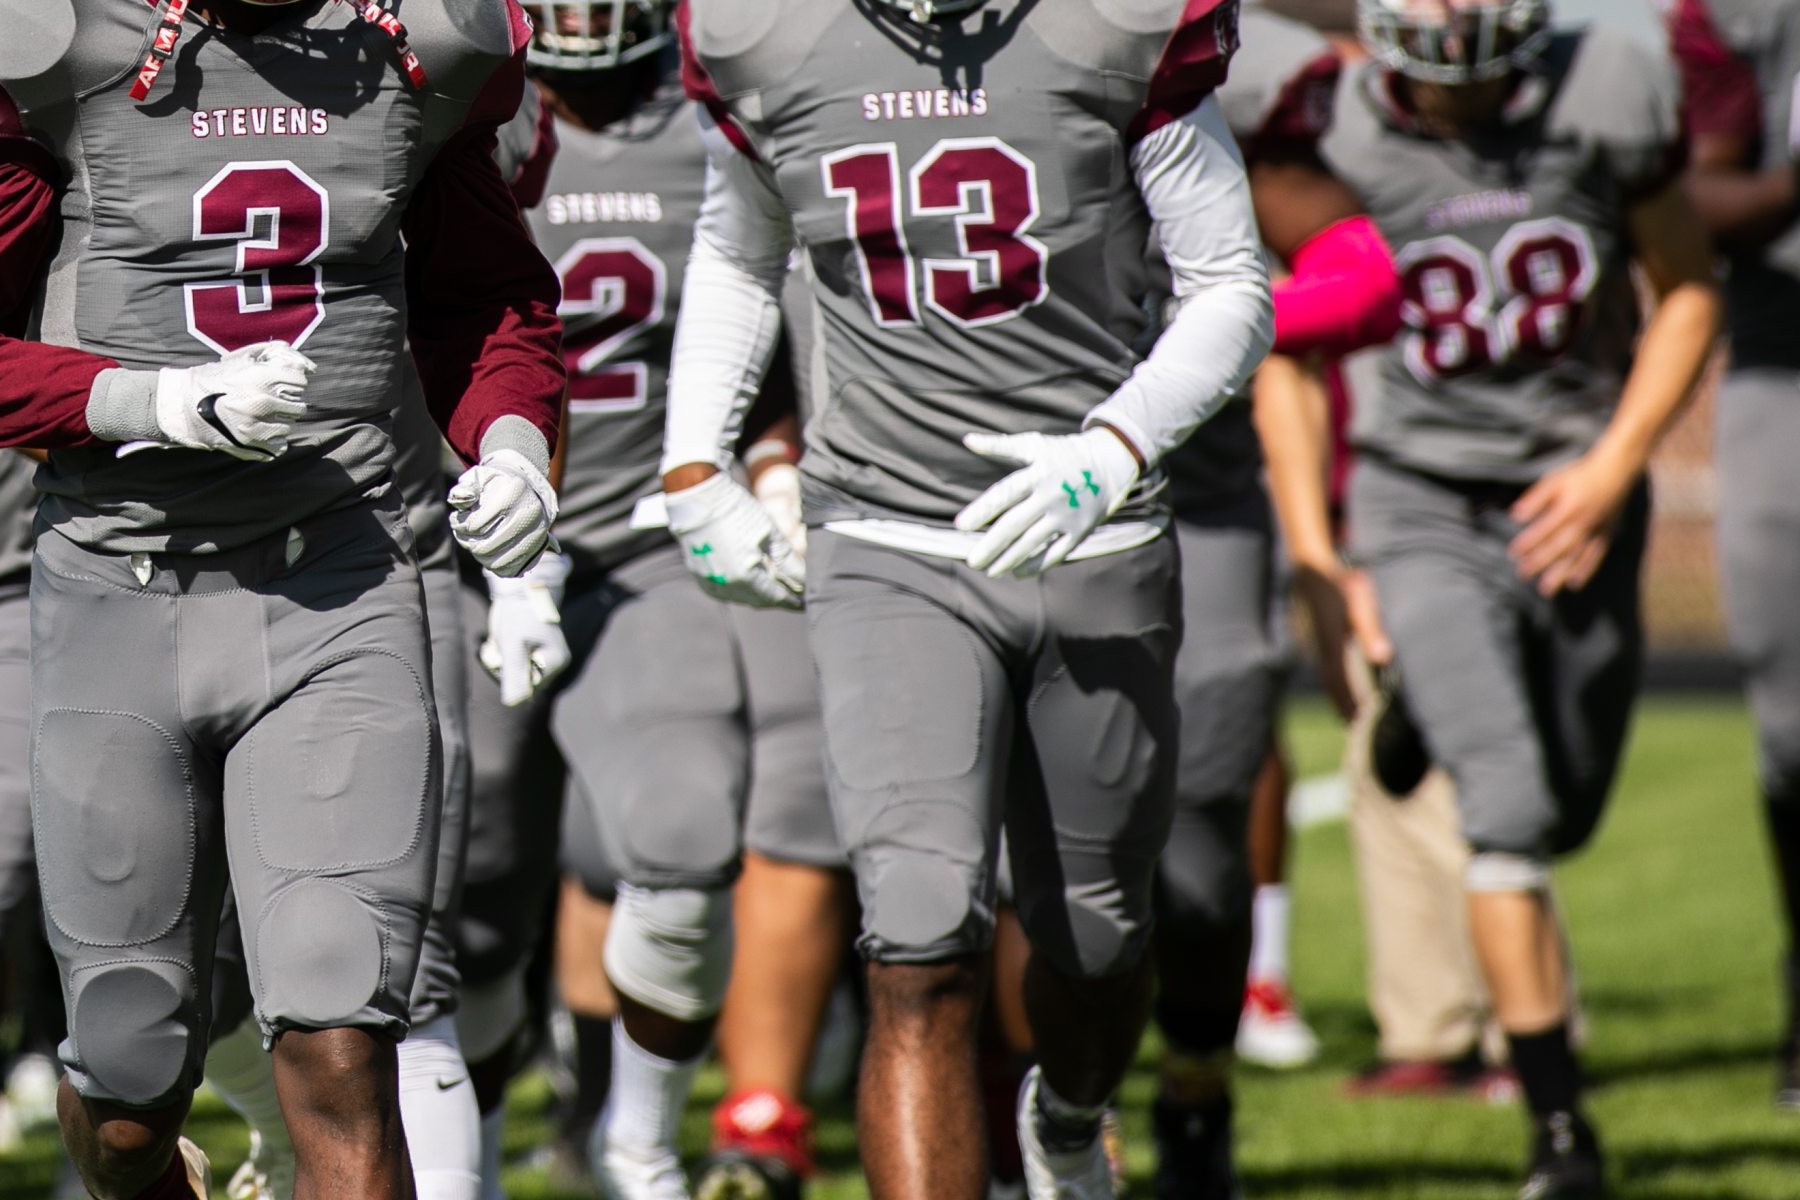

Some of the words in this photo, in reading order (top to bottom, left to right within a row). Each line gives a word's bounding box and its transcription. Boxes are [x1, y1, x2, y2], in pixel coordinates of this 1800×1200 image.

[191, 106, 329, 138] STEVENS
[861, 87, 989, 121] STEVENS
[183, 159, 330, 358] 3
[547, 191, 664, 226] STEVENS
[820, 136, 1050, 329] 13
[553, 236, 668, 414] 2
[1396, 215, 1599, 388] 88
